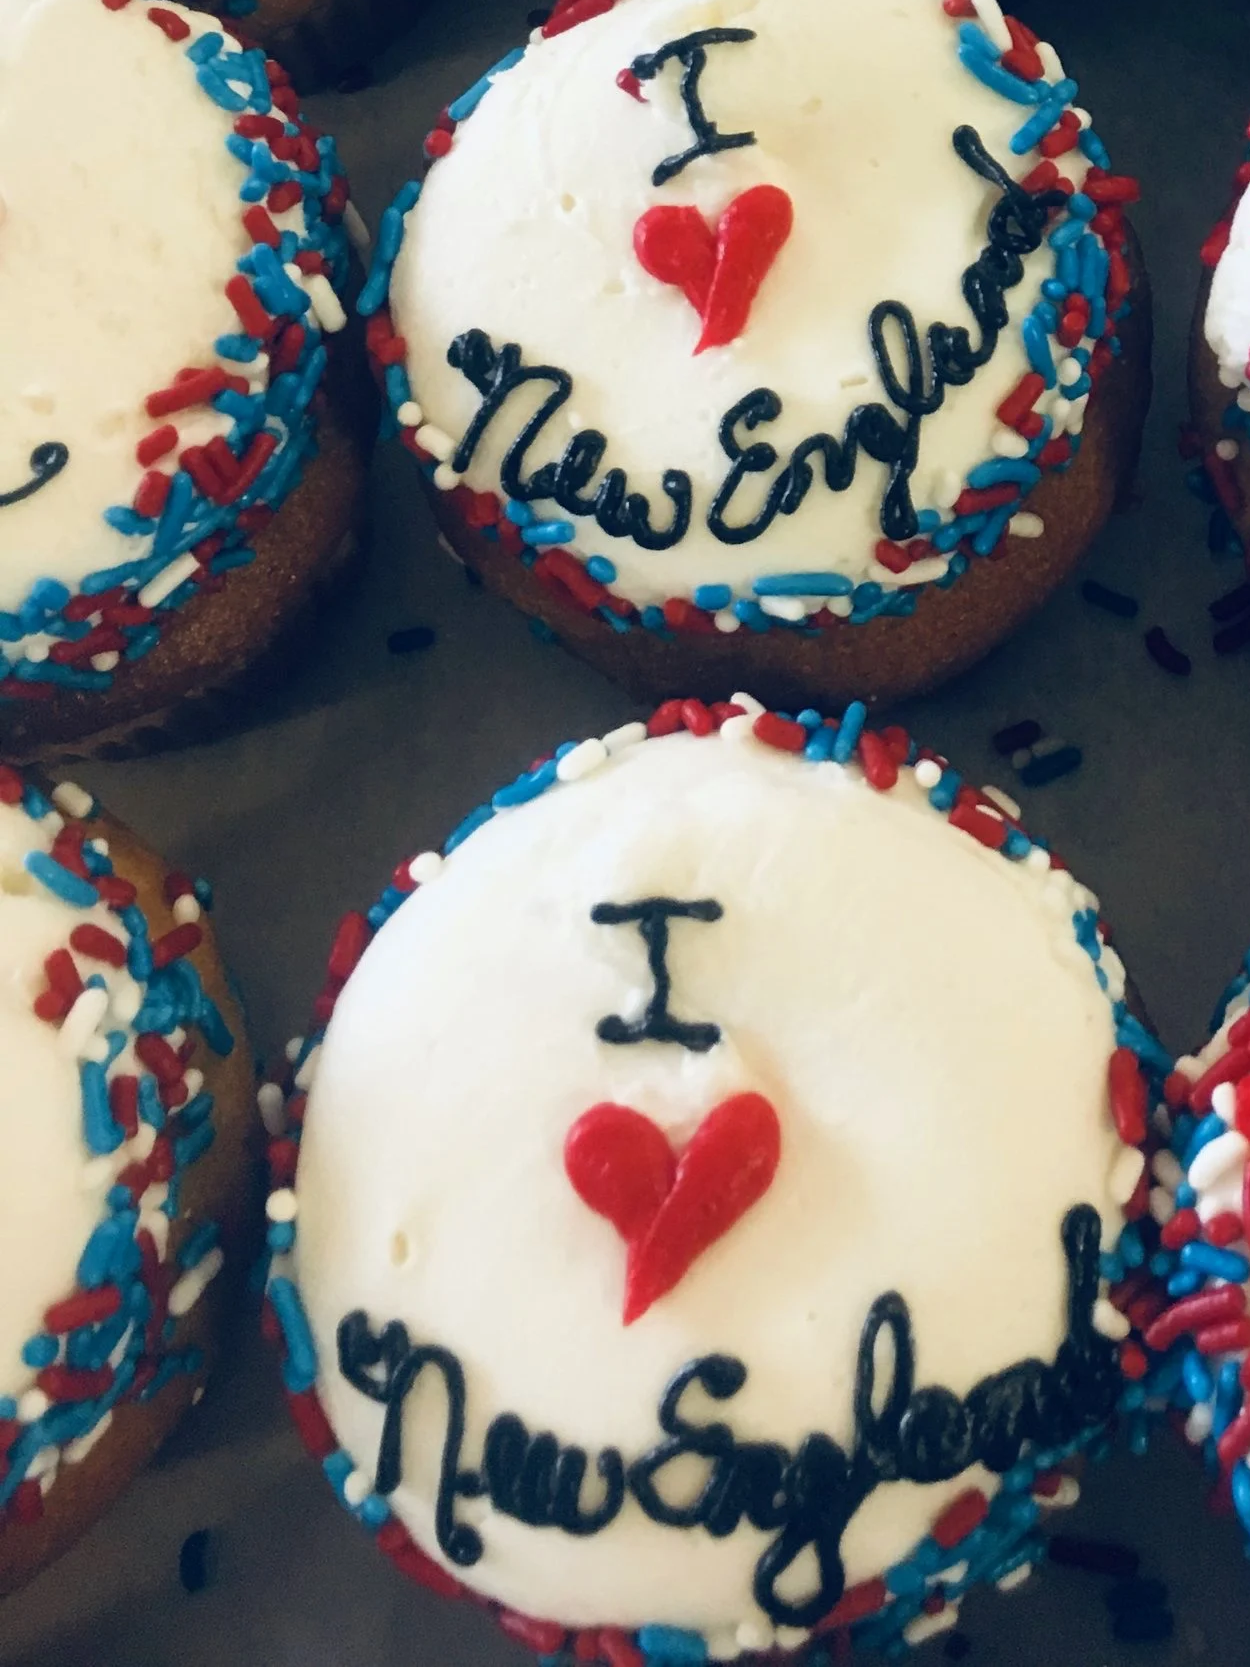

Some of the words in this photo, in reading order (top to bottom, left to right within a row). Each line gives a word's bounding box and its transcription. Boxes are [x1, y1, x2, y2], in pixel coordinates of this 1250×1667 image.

[630, 28, 757, 186] I
[447, 328, 692, 550] New
[707, 125, 1068, 541] England
[590, 898, 723, 1051] I
[336, 1309, 625, 1566] New
[628, 1202, 1122, 1629] England
